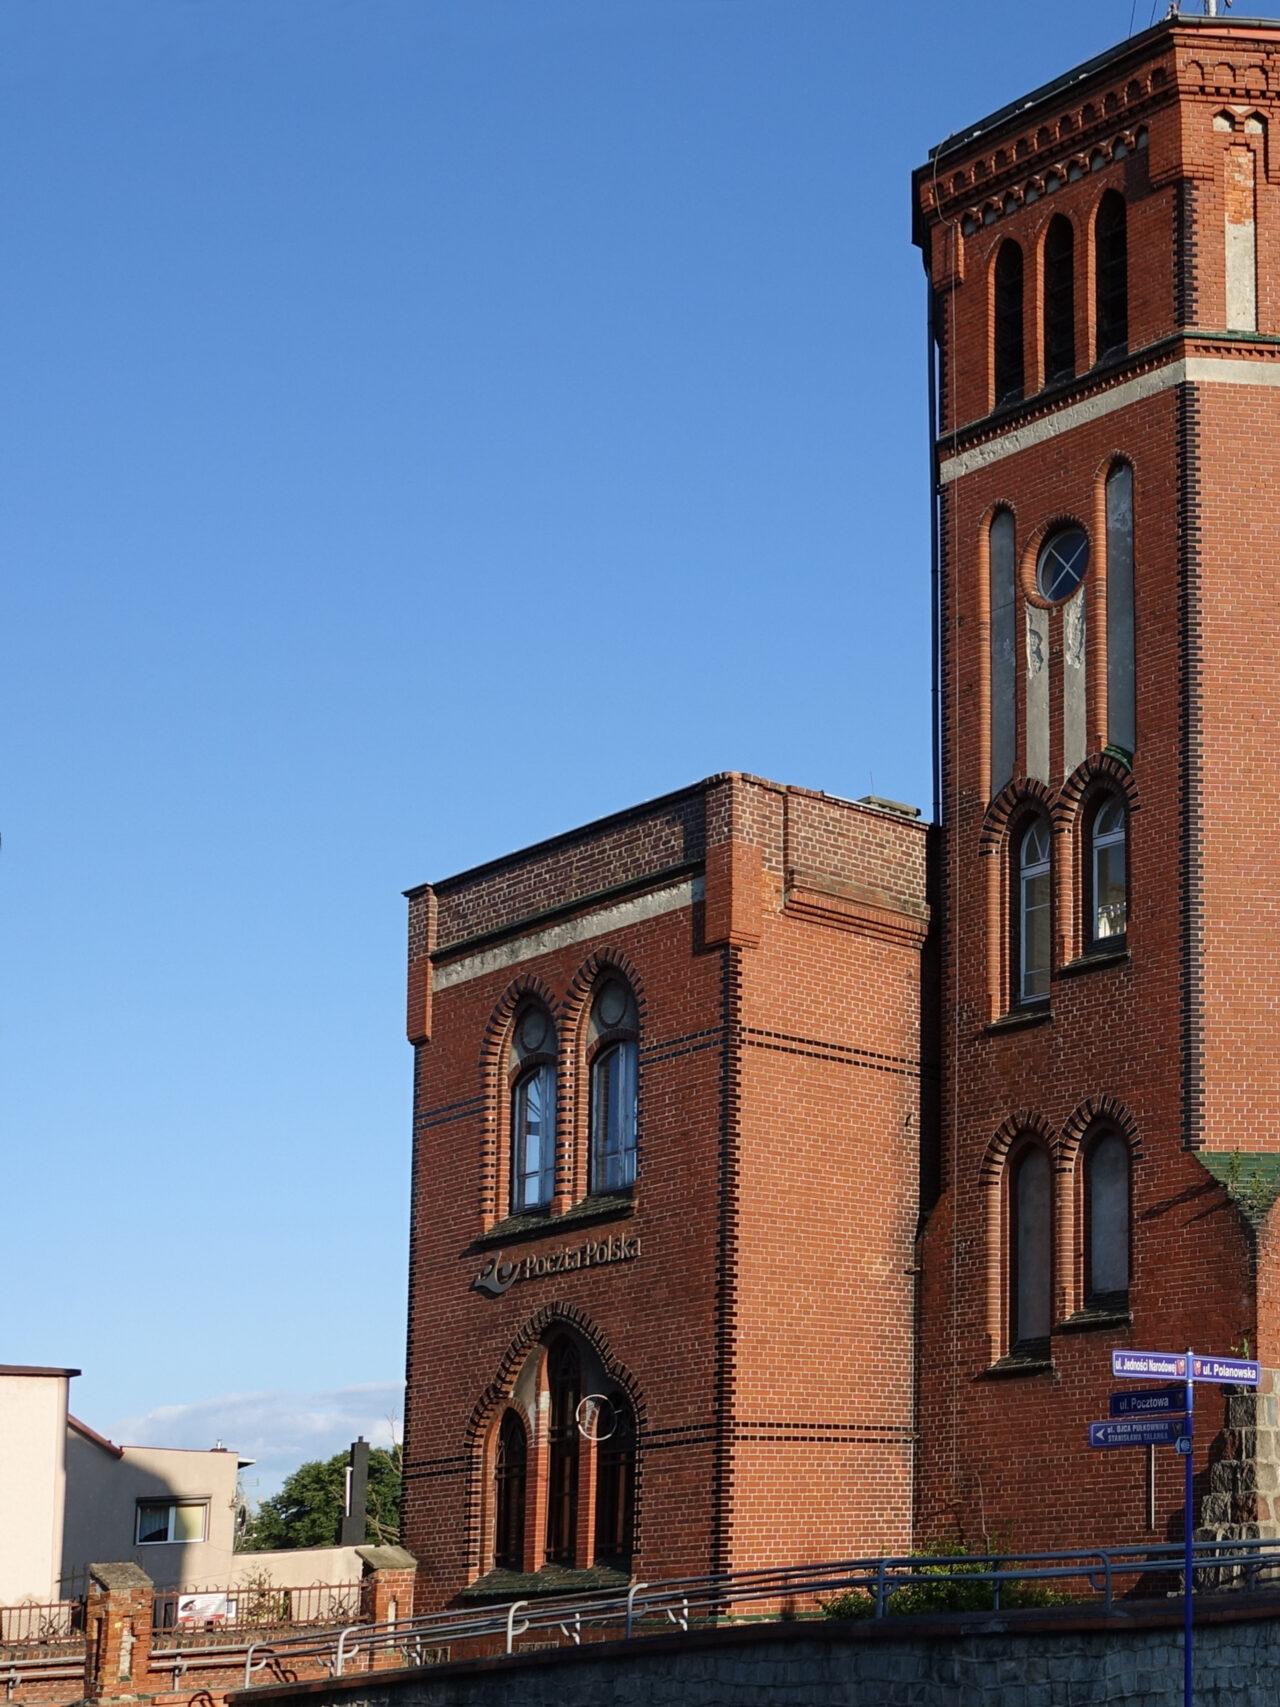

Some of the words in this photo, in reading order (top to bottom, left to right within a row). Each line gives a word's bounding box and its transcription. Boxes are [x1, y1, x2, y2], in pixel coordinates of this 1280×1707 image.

[525, 1247, 581, 1279] Poczta
[586, 1233, 642, 1267] Polska
[1123, 1357, 1148, 1372] Jedności
[1203, 1362, 1212, 1376] ul.
[1213, 1363, 1257, 1379] Polanowska
[1119, 1398, 1129, 1410] ul.
[1131, 1397, 1169, 1409] Pocztowa
